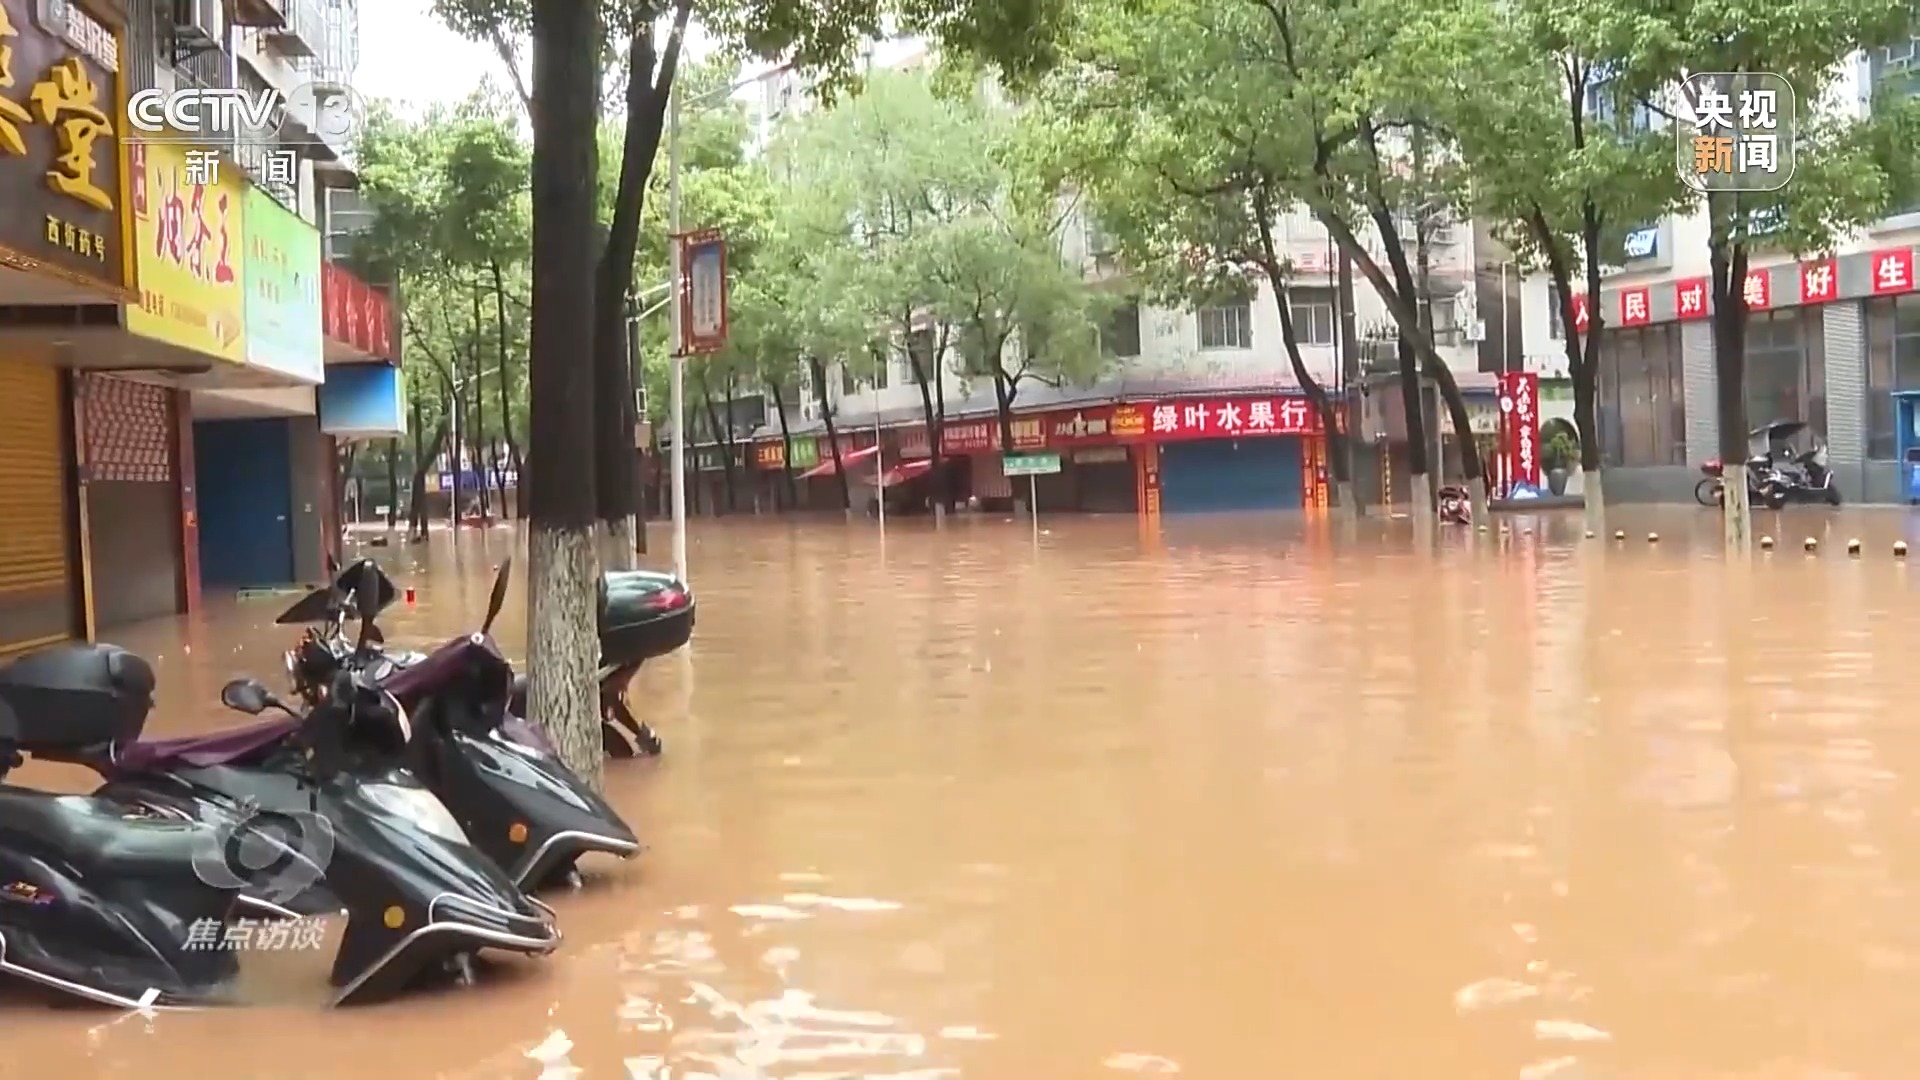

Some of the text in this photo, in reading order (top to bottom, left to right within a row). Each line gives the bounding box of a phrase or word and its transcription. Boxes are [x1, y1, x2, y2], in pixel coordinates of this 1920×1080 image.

[1152, 399, 1308, 433] 绿叶水果行
